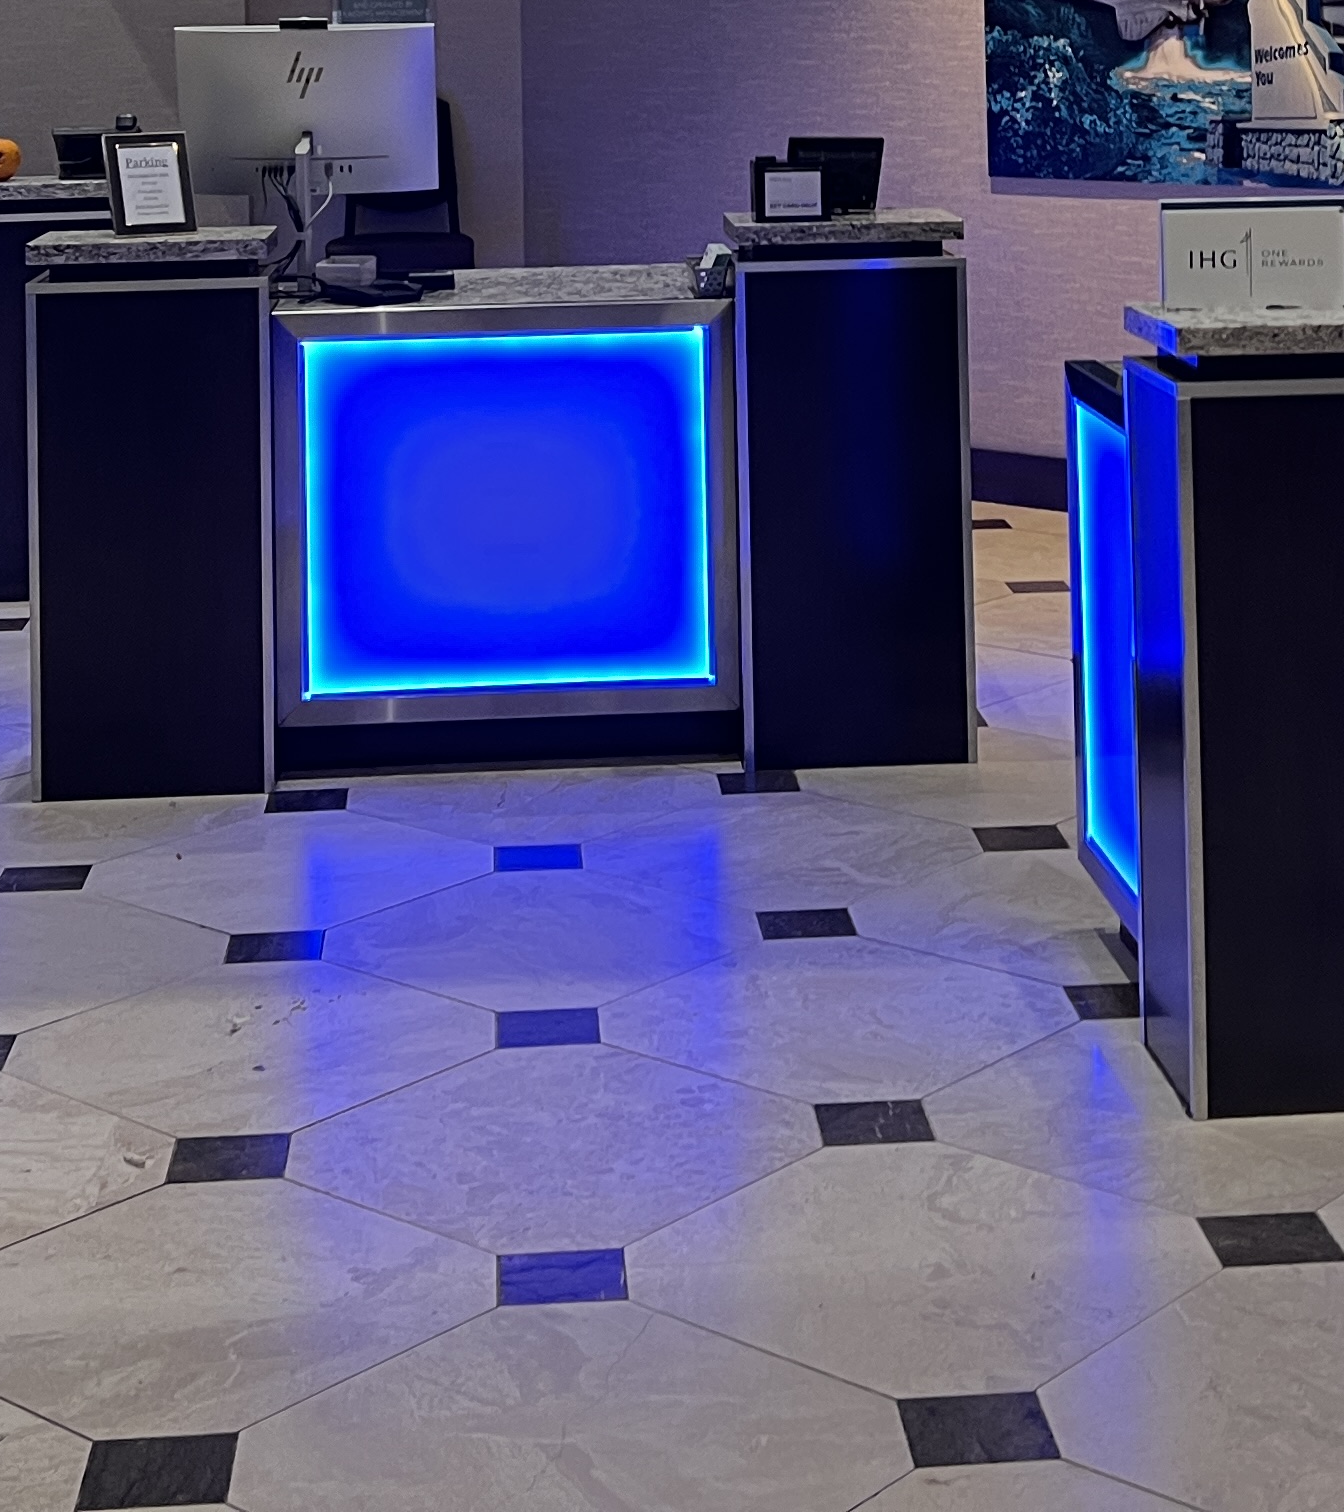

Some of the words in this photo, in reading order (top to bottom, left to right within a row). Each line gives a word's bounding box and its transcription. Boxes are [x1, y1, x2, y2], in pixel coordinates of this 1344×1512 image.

[1255, 40, 1309, 65] Welcomes
[1255, 71, 1274, 87] You
[125, 157, 169, 169] Parking
[1189, 249, 1237, 270] IHG
[1261, 249, 1288, 258] ONE
[1261, 259, 1324, 268] REWARDS
